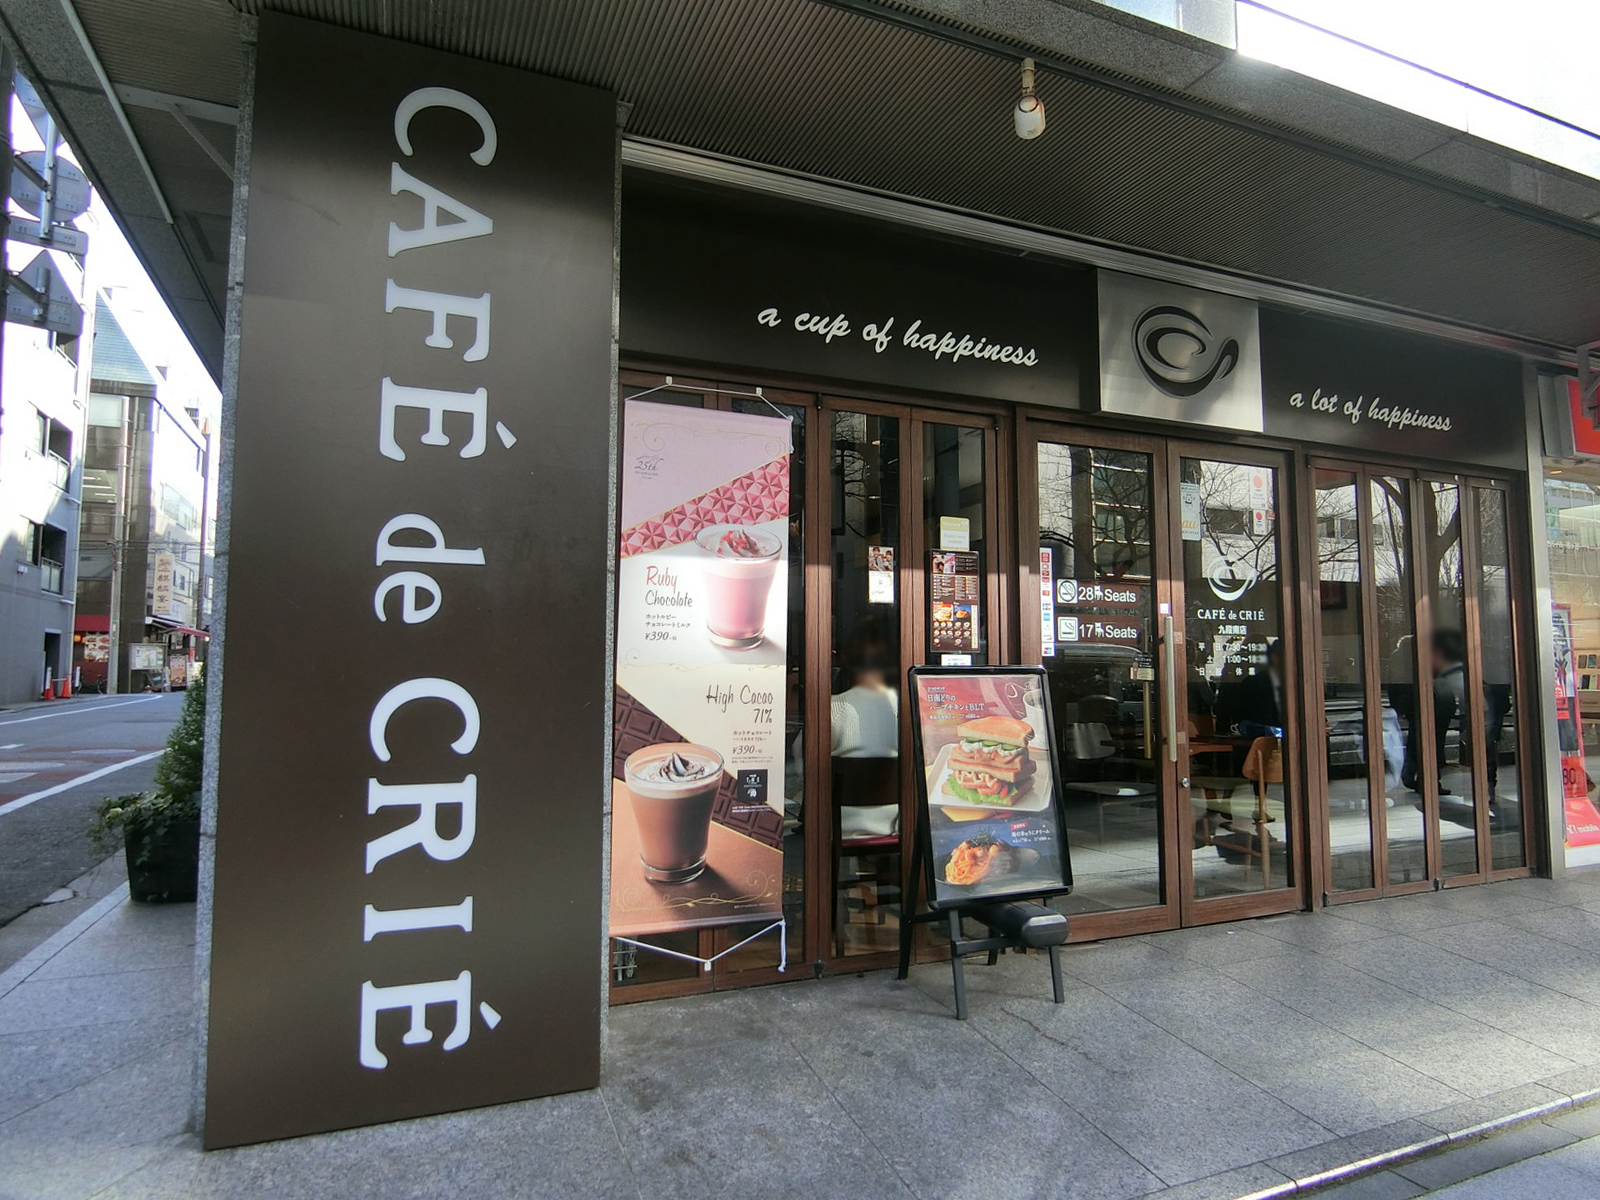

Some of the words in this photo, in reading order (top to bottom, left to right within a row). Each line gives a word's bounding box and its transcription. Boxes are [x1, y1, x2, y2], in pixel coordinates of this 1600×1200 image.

[379, 86, 517, 462] CAFÉ
[757, 307, 782, 328] a
[794, 312, 851, 343] cup
[862, 316, 895, 353] of
[903, 319, 1039, 367] happiness
[1289, 392, 1305, 408] a
[1310, 387, 1339, 413] lot
[1343, 395, 1363, 424] of
[1368, 397, 1452, 432] happiness
[374, 512, 486, 625] de
[646, 565, 678, 594] Ruby
[645, 589, 693, 607] Chocolate
[1078, 586, 1094, 601] 28
[1104, 588, 1137, 603] Seats
[1197, 607, 1227, 620] CAFÉ
[1228, 609, 1238, 620] de
[1239, 608, 1266, 621] CRIÉ
[1079, 624, 1094, 638] 17
[1105, 624, 1138, 639] Seats
[706, 684, 734, 714] High
[740, 684, 774, 705] Cacao
[754, 708, 773, 724] 71%
[360, 677, 502, 1070] CRIÉ
